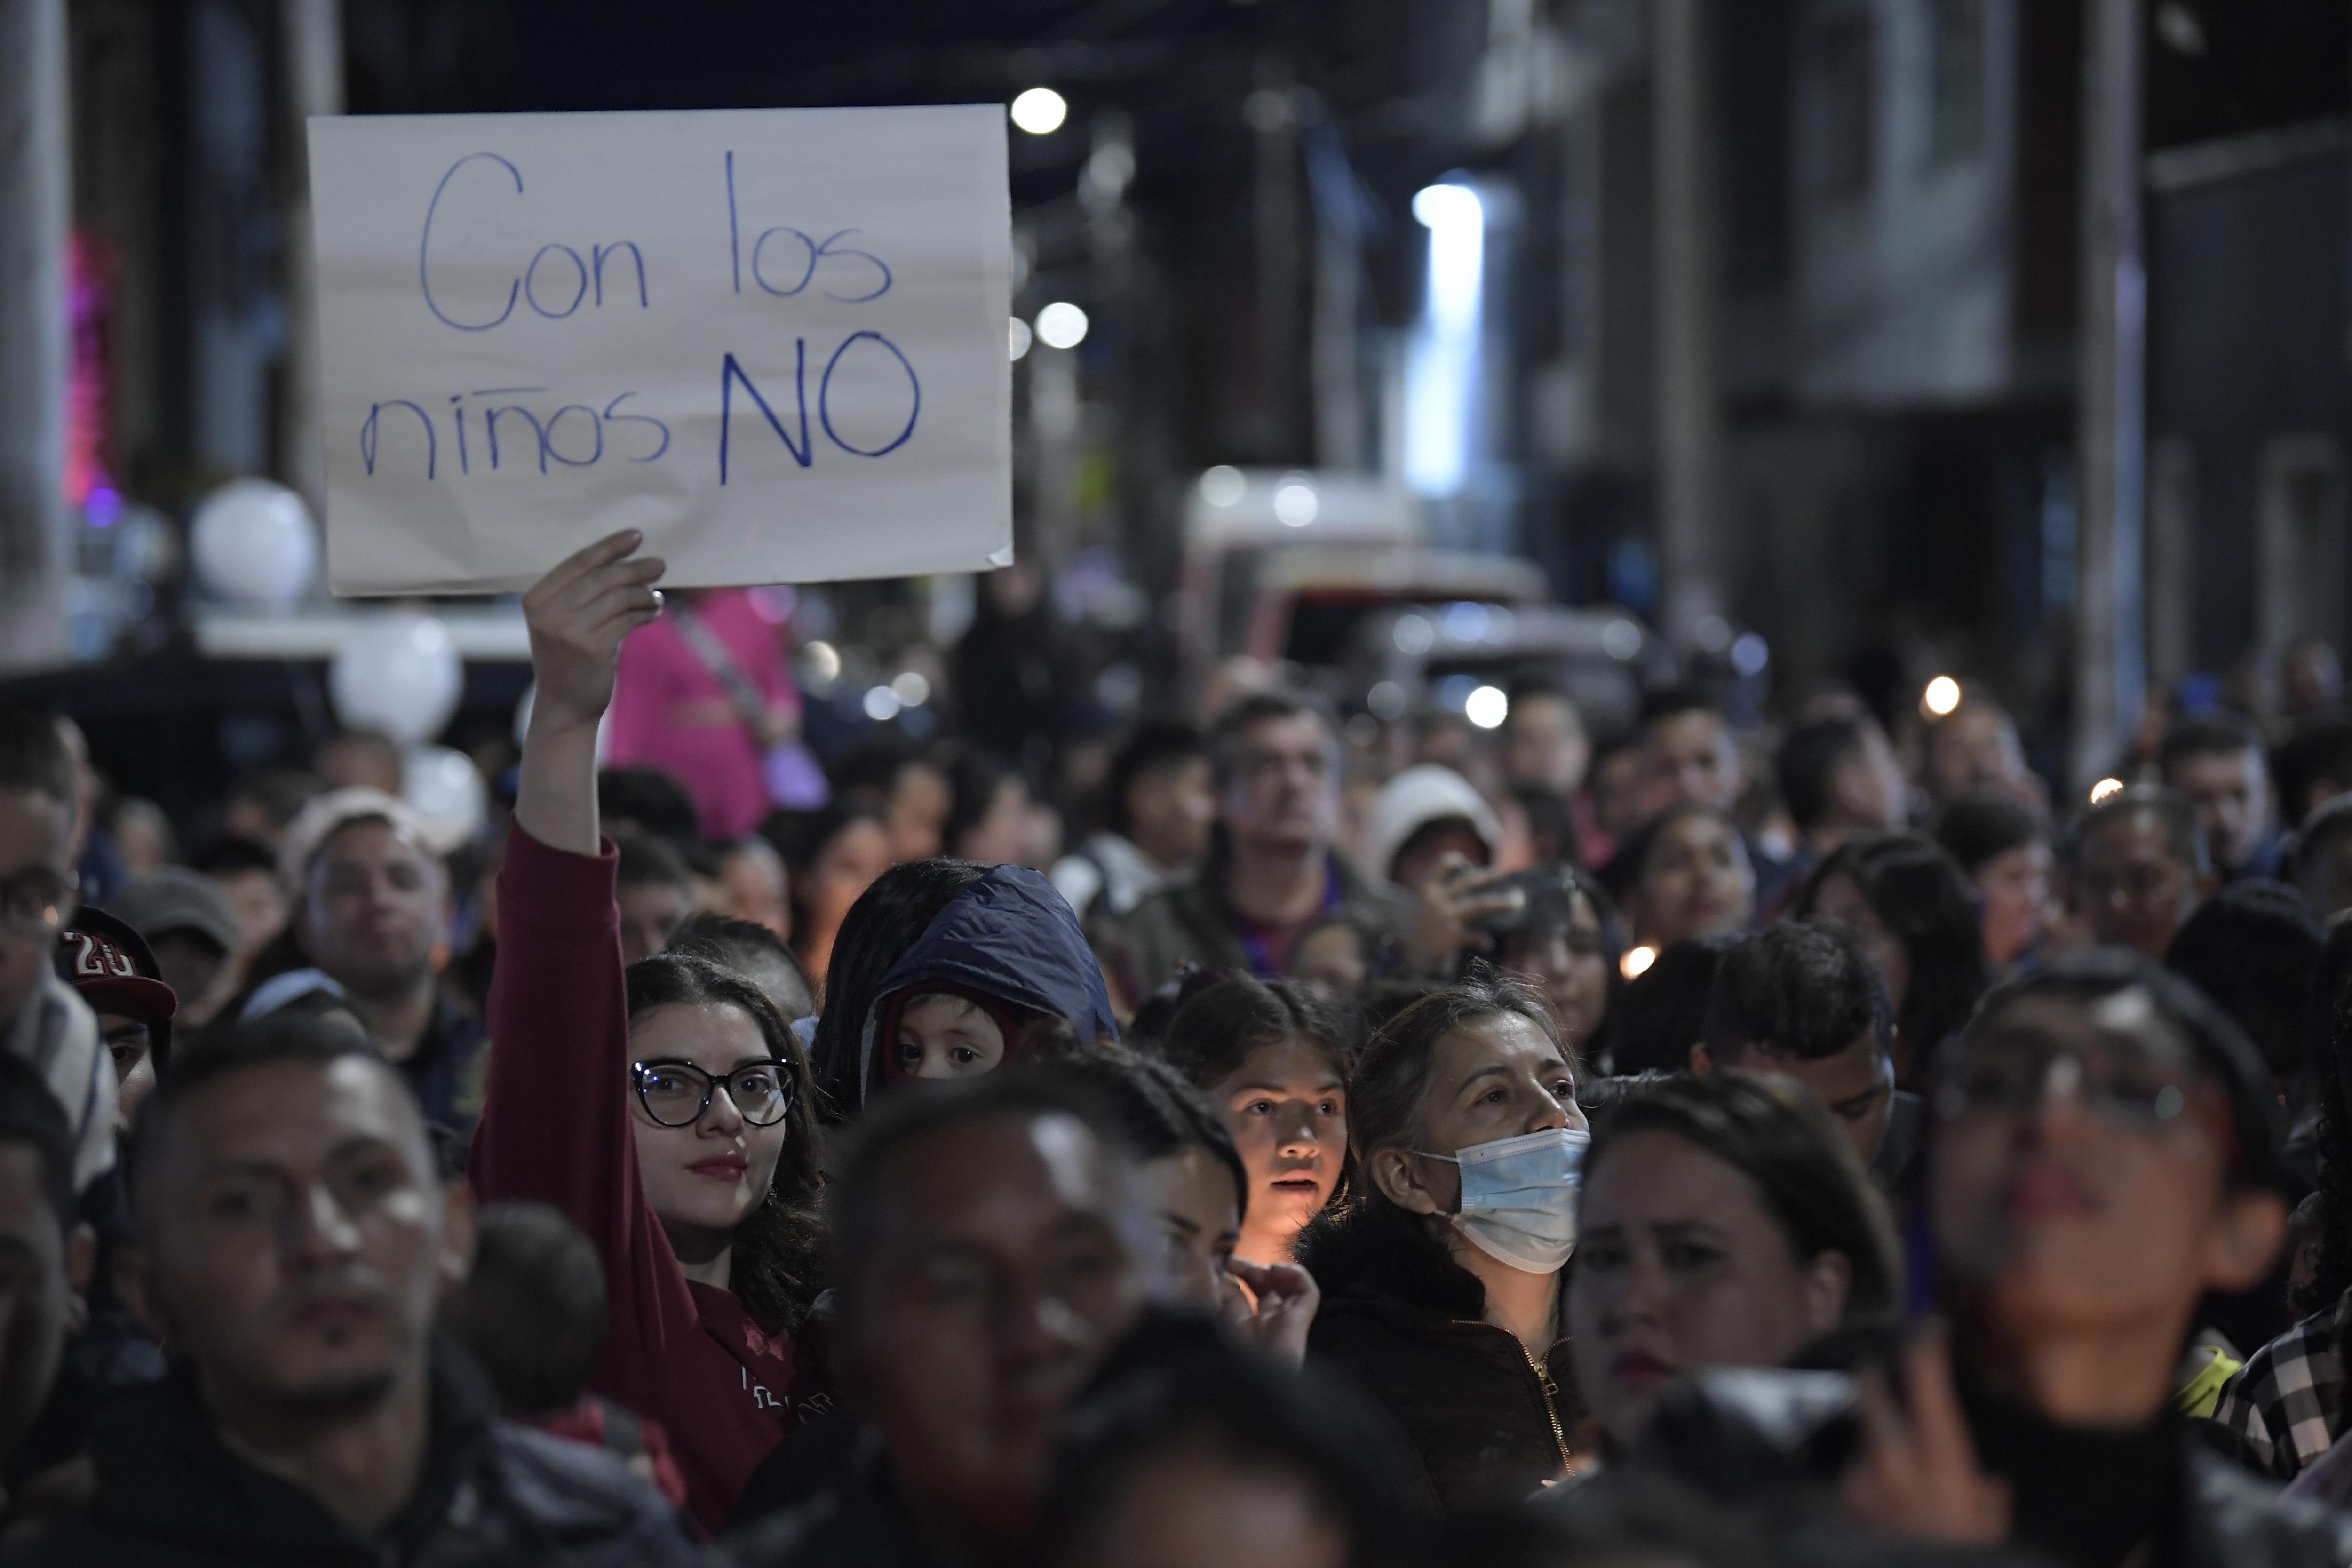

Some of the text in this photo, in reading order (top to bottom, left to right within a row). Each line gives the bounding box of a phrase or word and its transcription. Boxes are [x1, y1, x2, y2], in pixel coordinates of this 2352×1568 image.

[420, 150, 894, 332] Con los
[360, 330, 923, 486] niños NO
